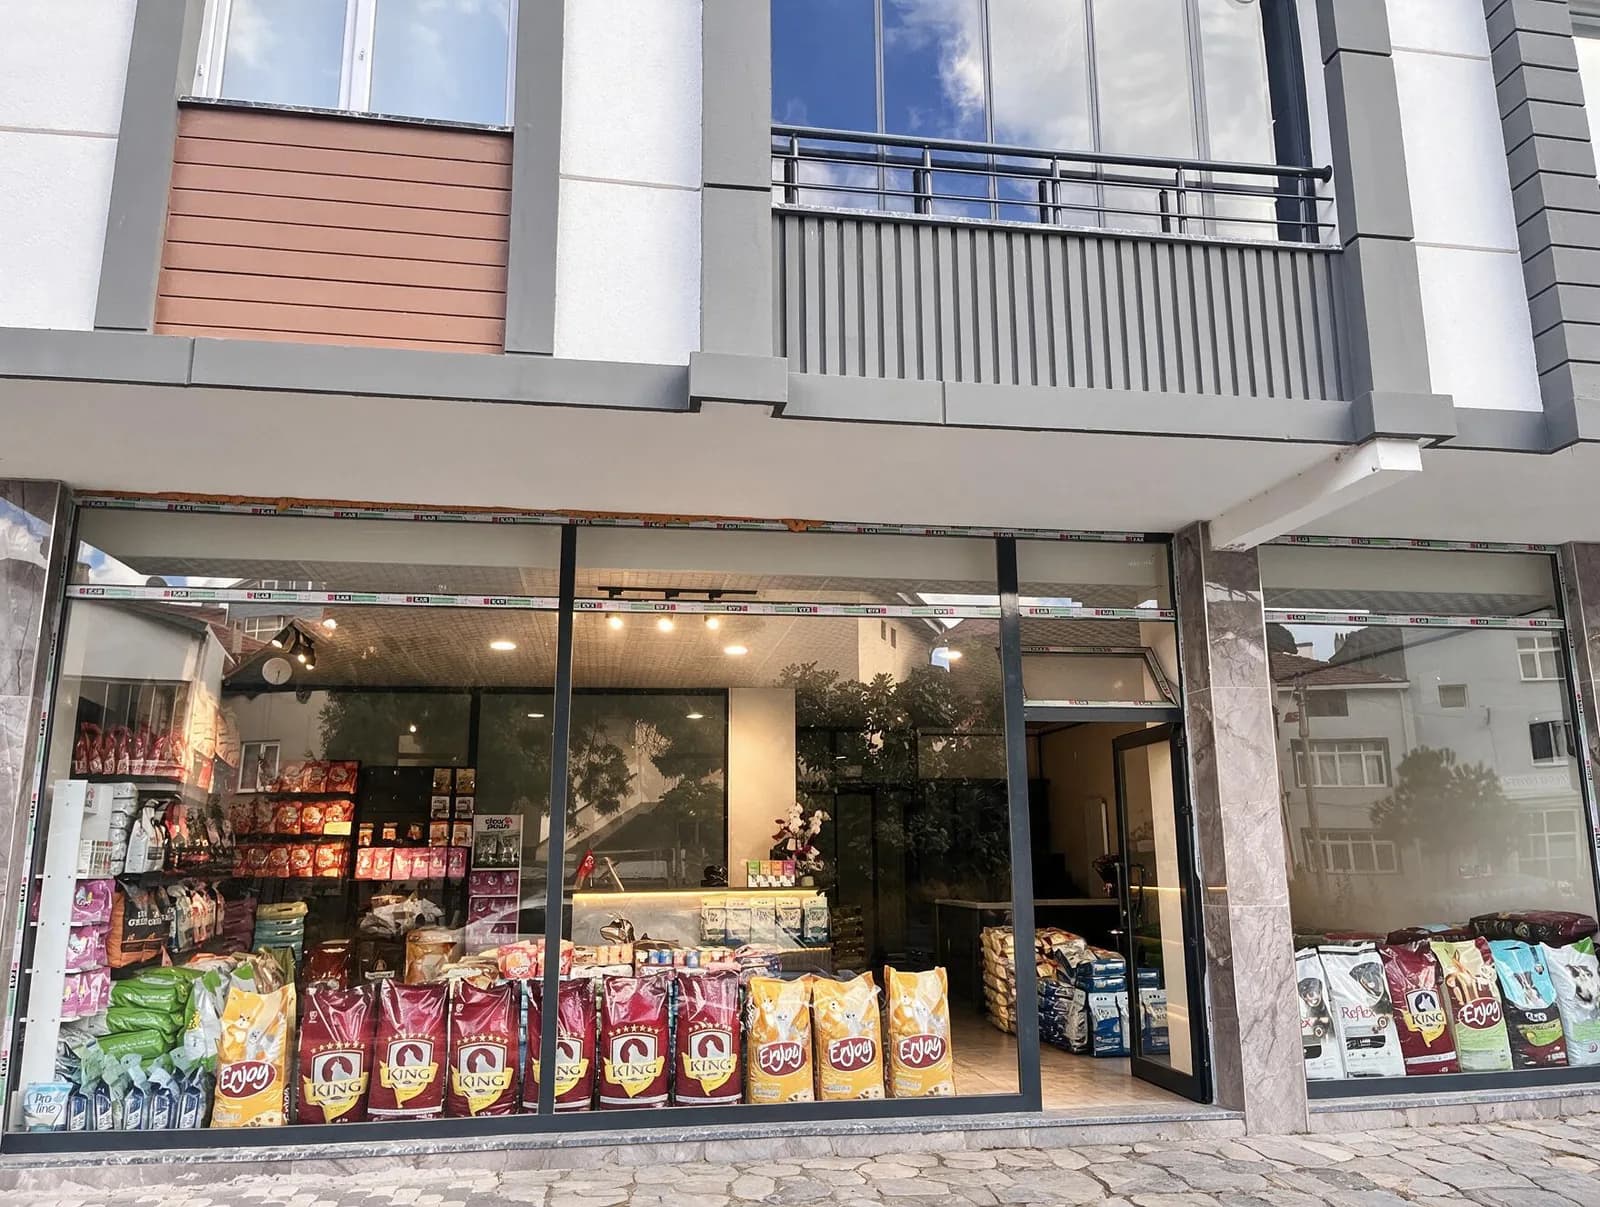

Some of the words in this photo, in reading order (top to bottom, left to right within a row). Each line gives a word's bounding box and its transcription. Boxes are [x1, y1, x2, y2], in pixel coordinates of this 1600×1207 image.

[1341, 1005, 1376, 1021] Reflex
[1412, 1013, 1444, 1025] KING
[1463, 1000, 1501, 1025] Enjoy
[759, 1043, 803, 1072] Enjoy
[829, 1038, 874, 1067] Enjoy
[900, 1036, 943, 1065] Enjoy
[557, 1064, 581, 1077] NG
[612, 1063, 657, 1078] KING
[690, 1059, 732, 1072] KING
[219, 1064, 270, 1093] Enjoy
[386, 1068, 431, 1082] KING
[458, 1074, 505, 1088] KING
[311, 1078, 361, 1097] KING
[34, 1093, 52, 1104] Pro
[34, 1101, 57, 1114] line
